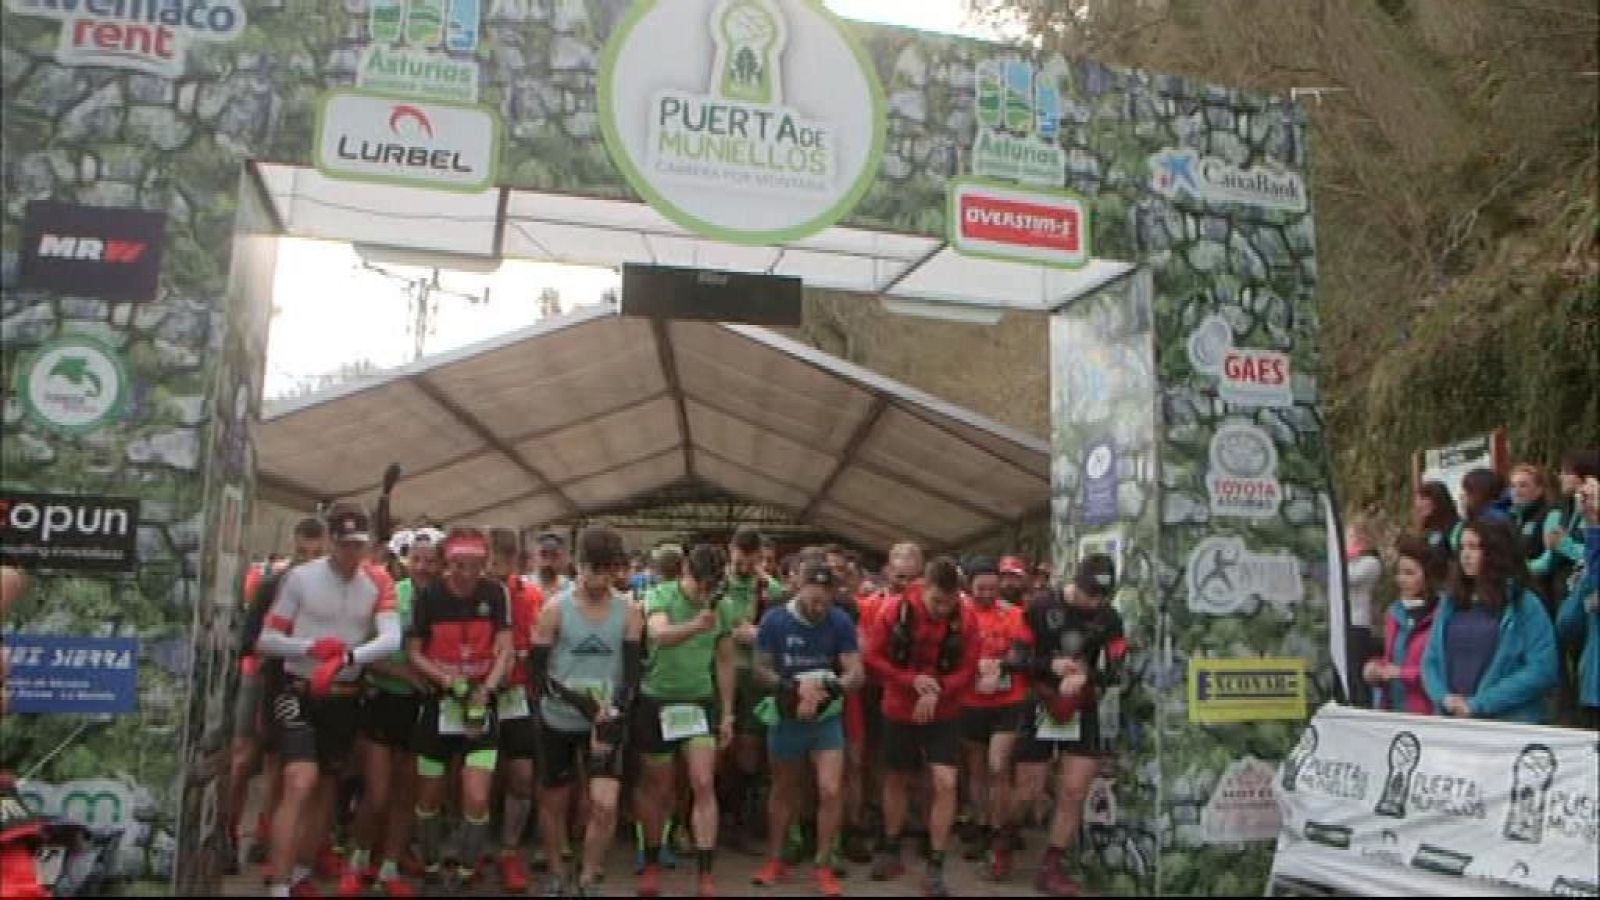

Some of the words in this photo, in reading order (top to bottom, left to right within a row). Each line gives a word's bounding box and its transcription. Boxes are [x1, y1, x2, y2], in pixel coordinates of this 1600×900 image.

[73, 19, 176, 60] rent
[368, 51, 472, 82] Asturias
[659, 97, 798, 143] PUERTA
[799, 128, 827, 149] DE
[337, 134, 473, 173] LURBEL
[658, 132, 827, 174] MUNIELLOS
[1203, 159, 1298, 200] CaixaBank
[38, 234, 147, 263] MRW
[1225, 355, 1285, 385] GAES
[1215, 480, 1276, 497] TOYOTA
